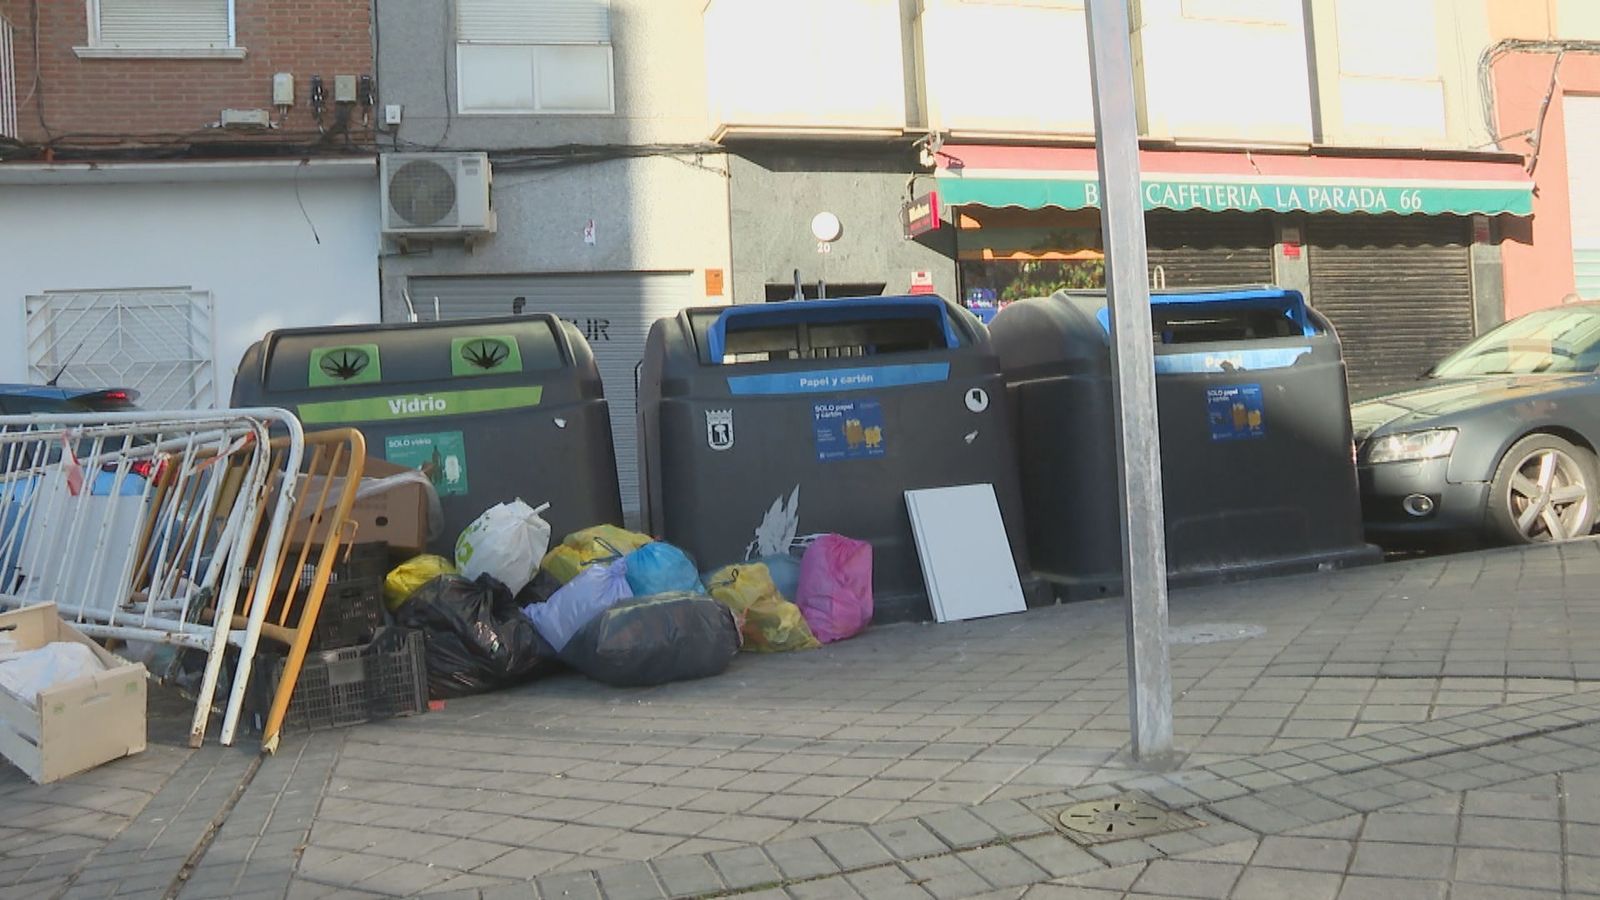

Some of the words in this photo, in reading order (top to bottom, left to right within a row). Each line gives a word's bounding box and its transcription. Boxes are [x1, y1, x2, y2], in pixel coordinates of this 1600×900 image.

[1145, 183, 1263, 207] CAFETERIA
[1275, 186, 1301, 208] LA
[1308, 187, 1388, 209] PARADA
[1400, 188, 1422, 210] 66
[816, 241, 832, 253] 20
[799, 376, 829, 388] Papel
[831, 377, 838, 386] y
[840, 374, 874, 385] cartón
[387, 396, 447, 415] Vidrio
[814, 404, 835, 413] SOLO
[388, 439, 410, 448] SOLO
